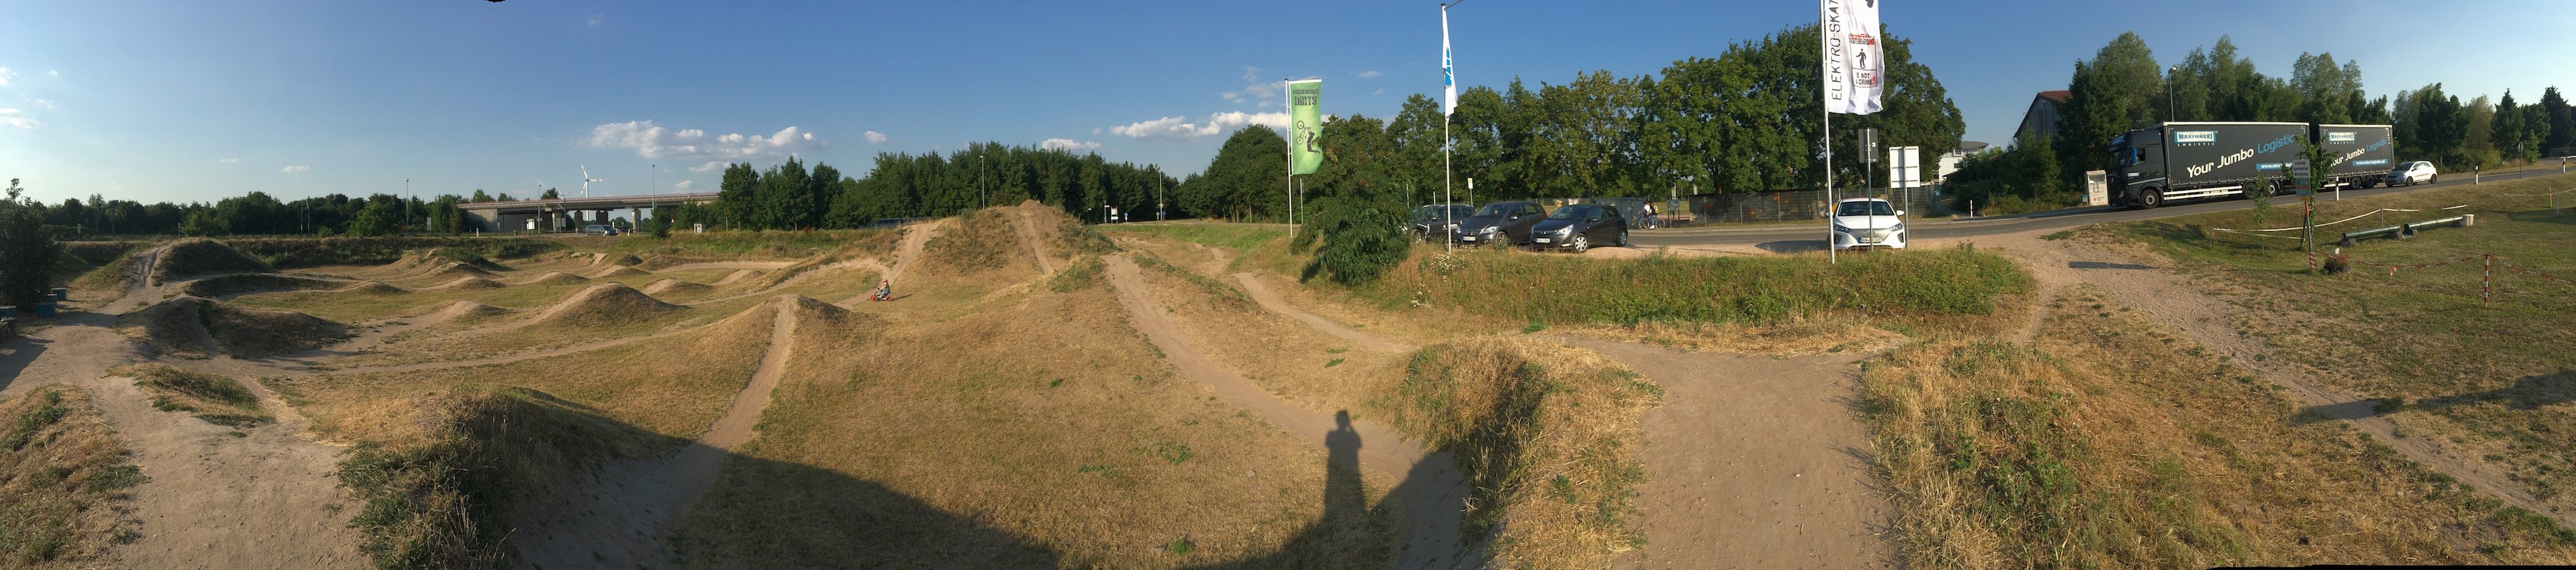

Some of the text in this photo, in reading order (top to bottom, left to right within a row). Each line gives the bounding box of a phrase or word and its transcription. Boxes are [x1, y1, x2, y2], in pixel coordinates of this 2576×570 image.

[2187, 134, 2295, 178] Your Jumbo Logistic
[2331, 137, 2388, 167] our Jumbo Logistic
